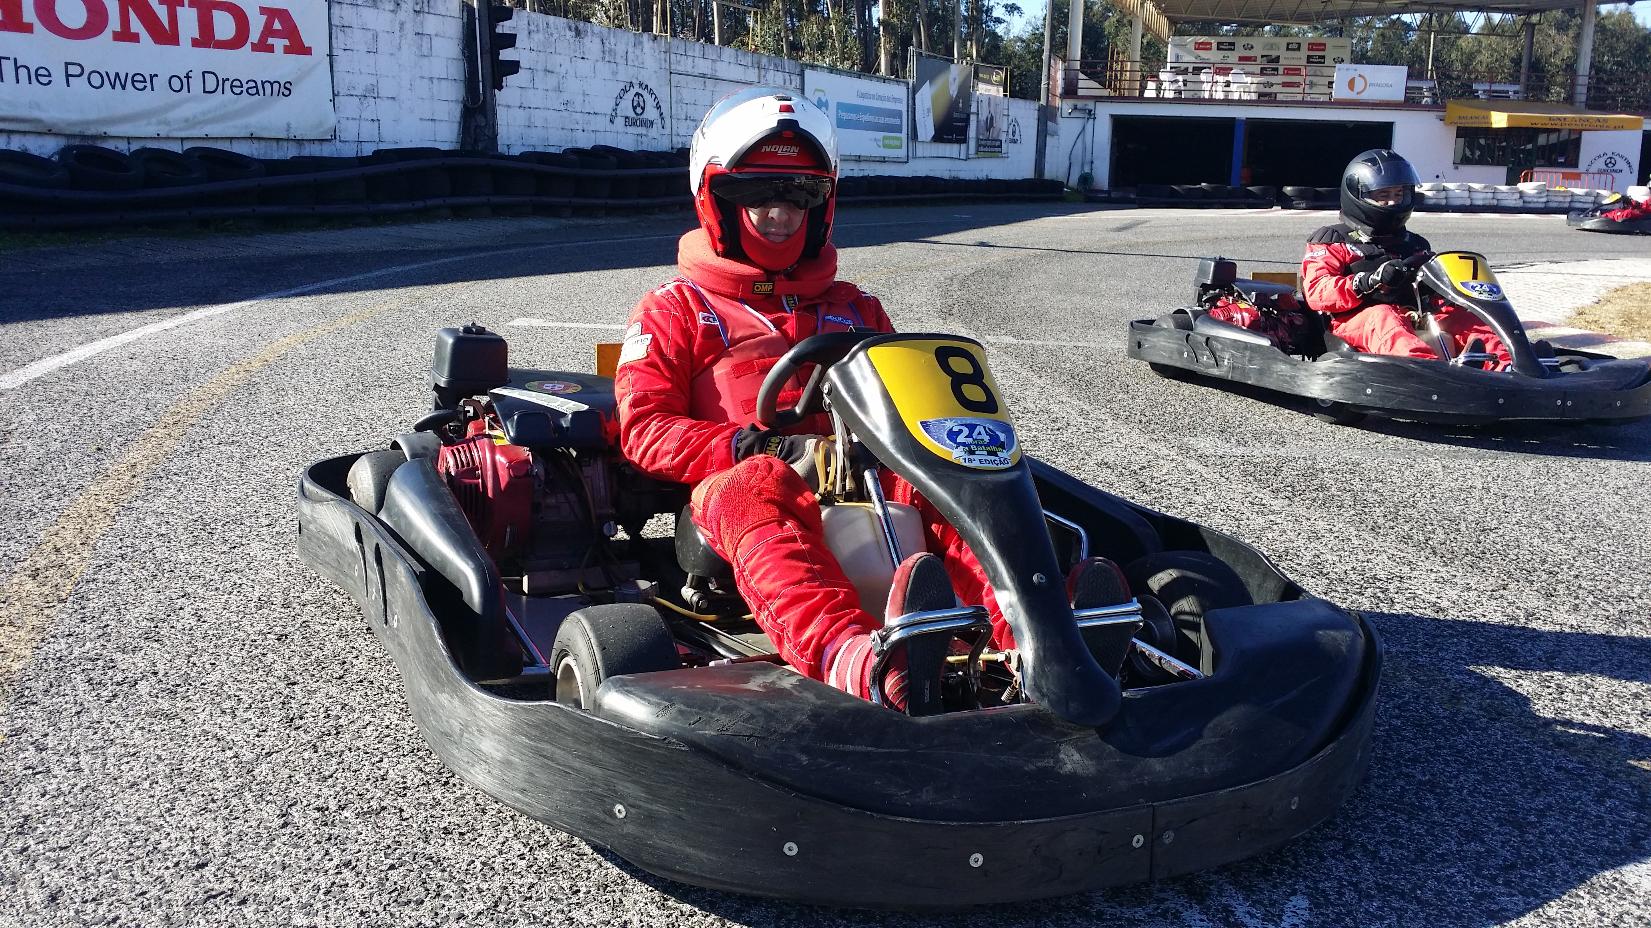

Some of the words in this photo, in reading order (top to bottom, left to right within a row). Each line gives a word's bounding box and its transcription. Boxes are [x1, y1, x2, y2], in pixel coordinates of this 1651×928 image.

[64, 62, 159, 92] Power
[168, 70, 194, 94] of
[202, 71, 293, 98] Dreams
[761, 144, 800, 155] NOLAN
[1457, 255, 1479, 281] 7
[753, 284, 773, 292] OMP
[934, 345, 999, 414] 8
[952, 425, 990, 443] 24
[971, 444, 1004, 453] Batalha
